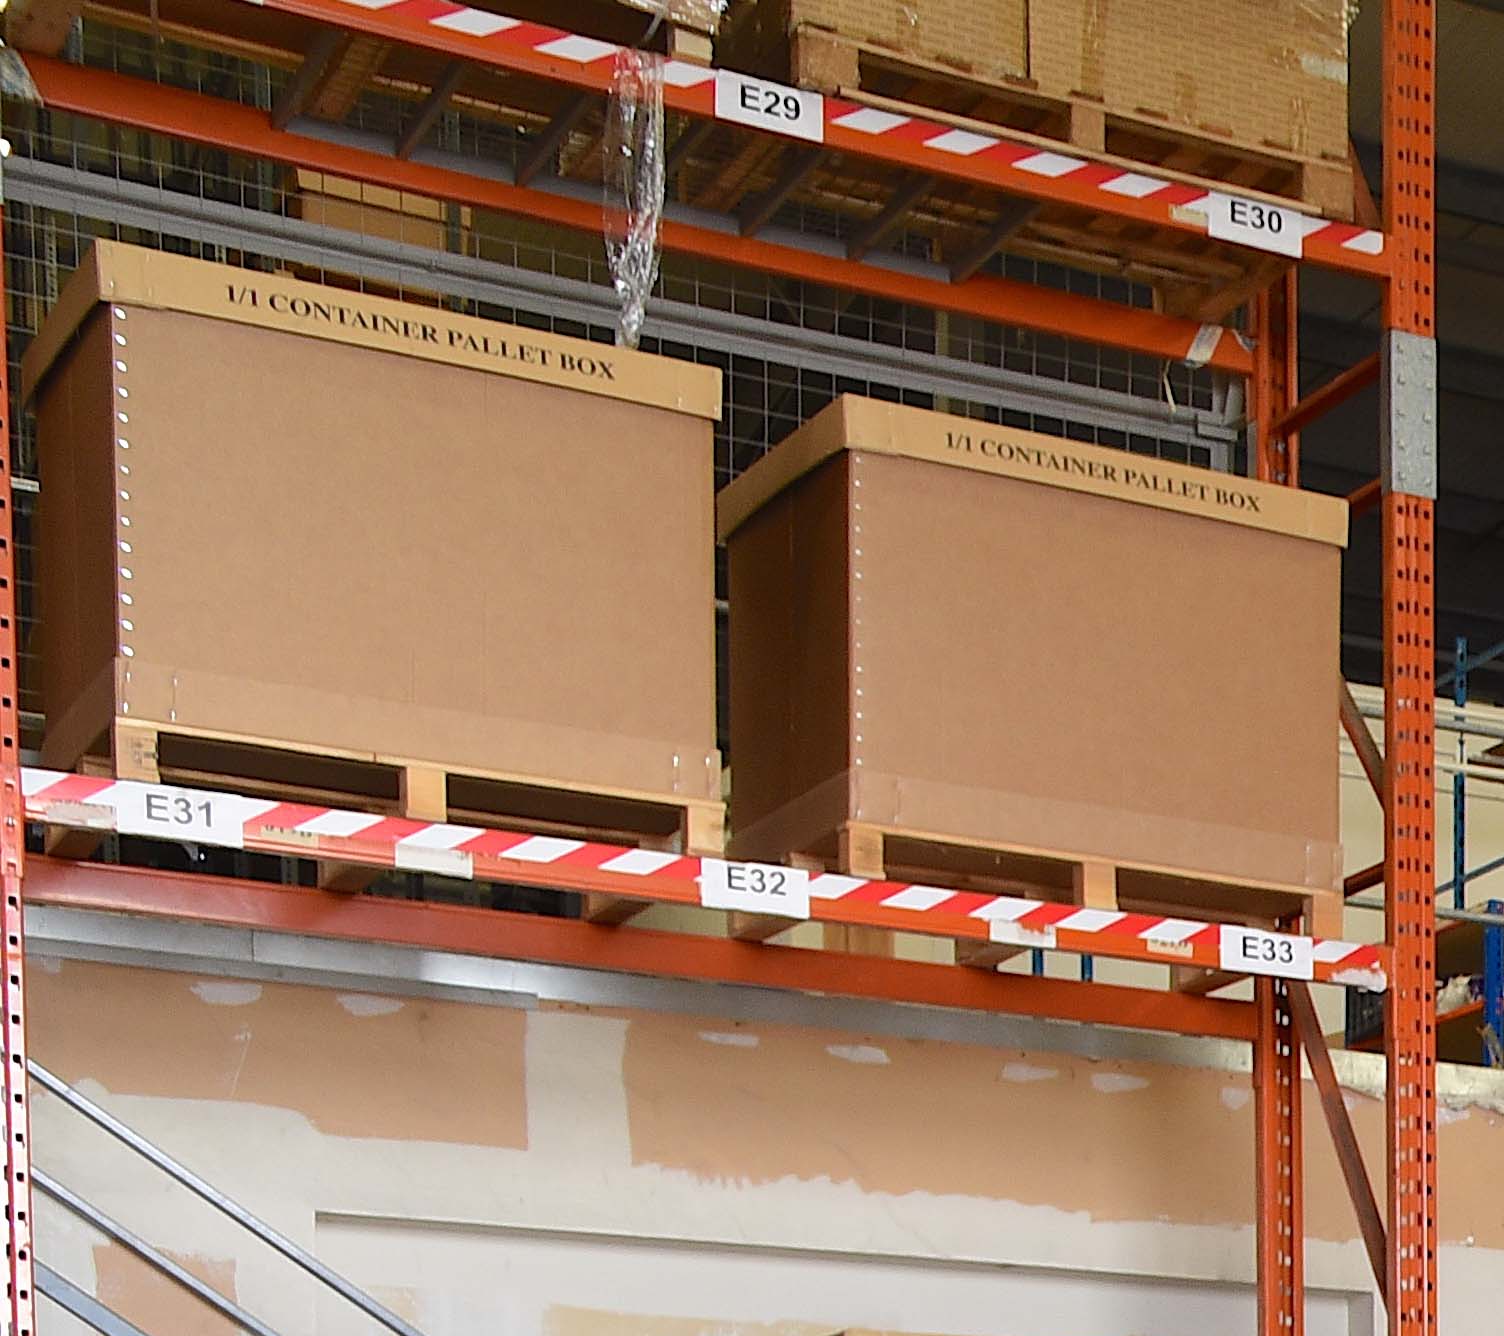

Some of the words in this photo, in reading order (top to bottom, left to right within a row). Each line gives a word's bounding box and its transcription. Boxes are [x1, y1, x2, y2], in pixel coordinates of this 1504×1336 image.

[738, 83, 802, 121] E29
[1229, 202, 1284, 235] E30
[225, 284, 259, 307] 1/1
[269, 293, 439, 344] CONTAINER
[447, 331, 552, 366] PALLET
[560, 353, 616, 380] BOX
[945, 431, 973, 453] 1/1
[980, 439, 1118, 481] CONTAINER
[1124, 469, 1210, 501] PALLET
[1215, 489, 1262, 512] BOX
[145, 793, 213, 828] E31
[726, 864, 787, 897] E32
[1242, 935, 1293, 963] E33
